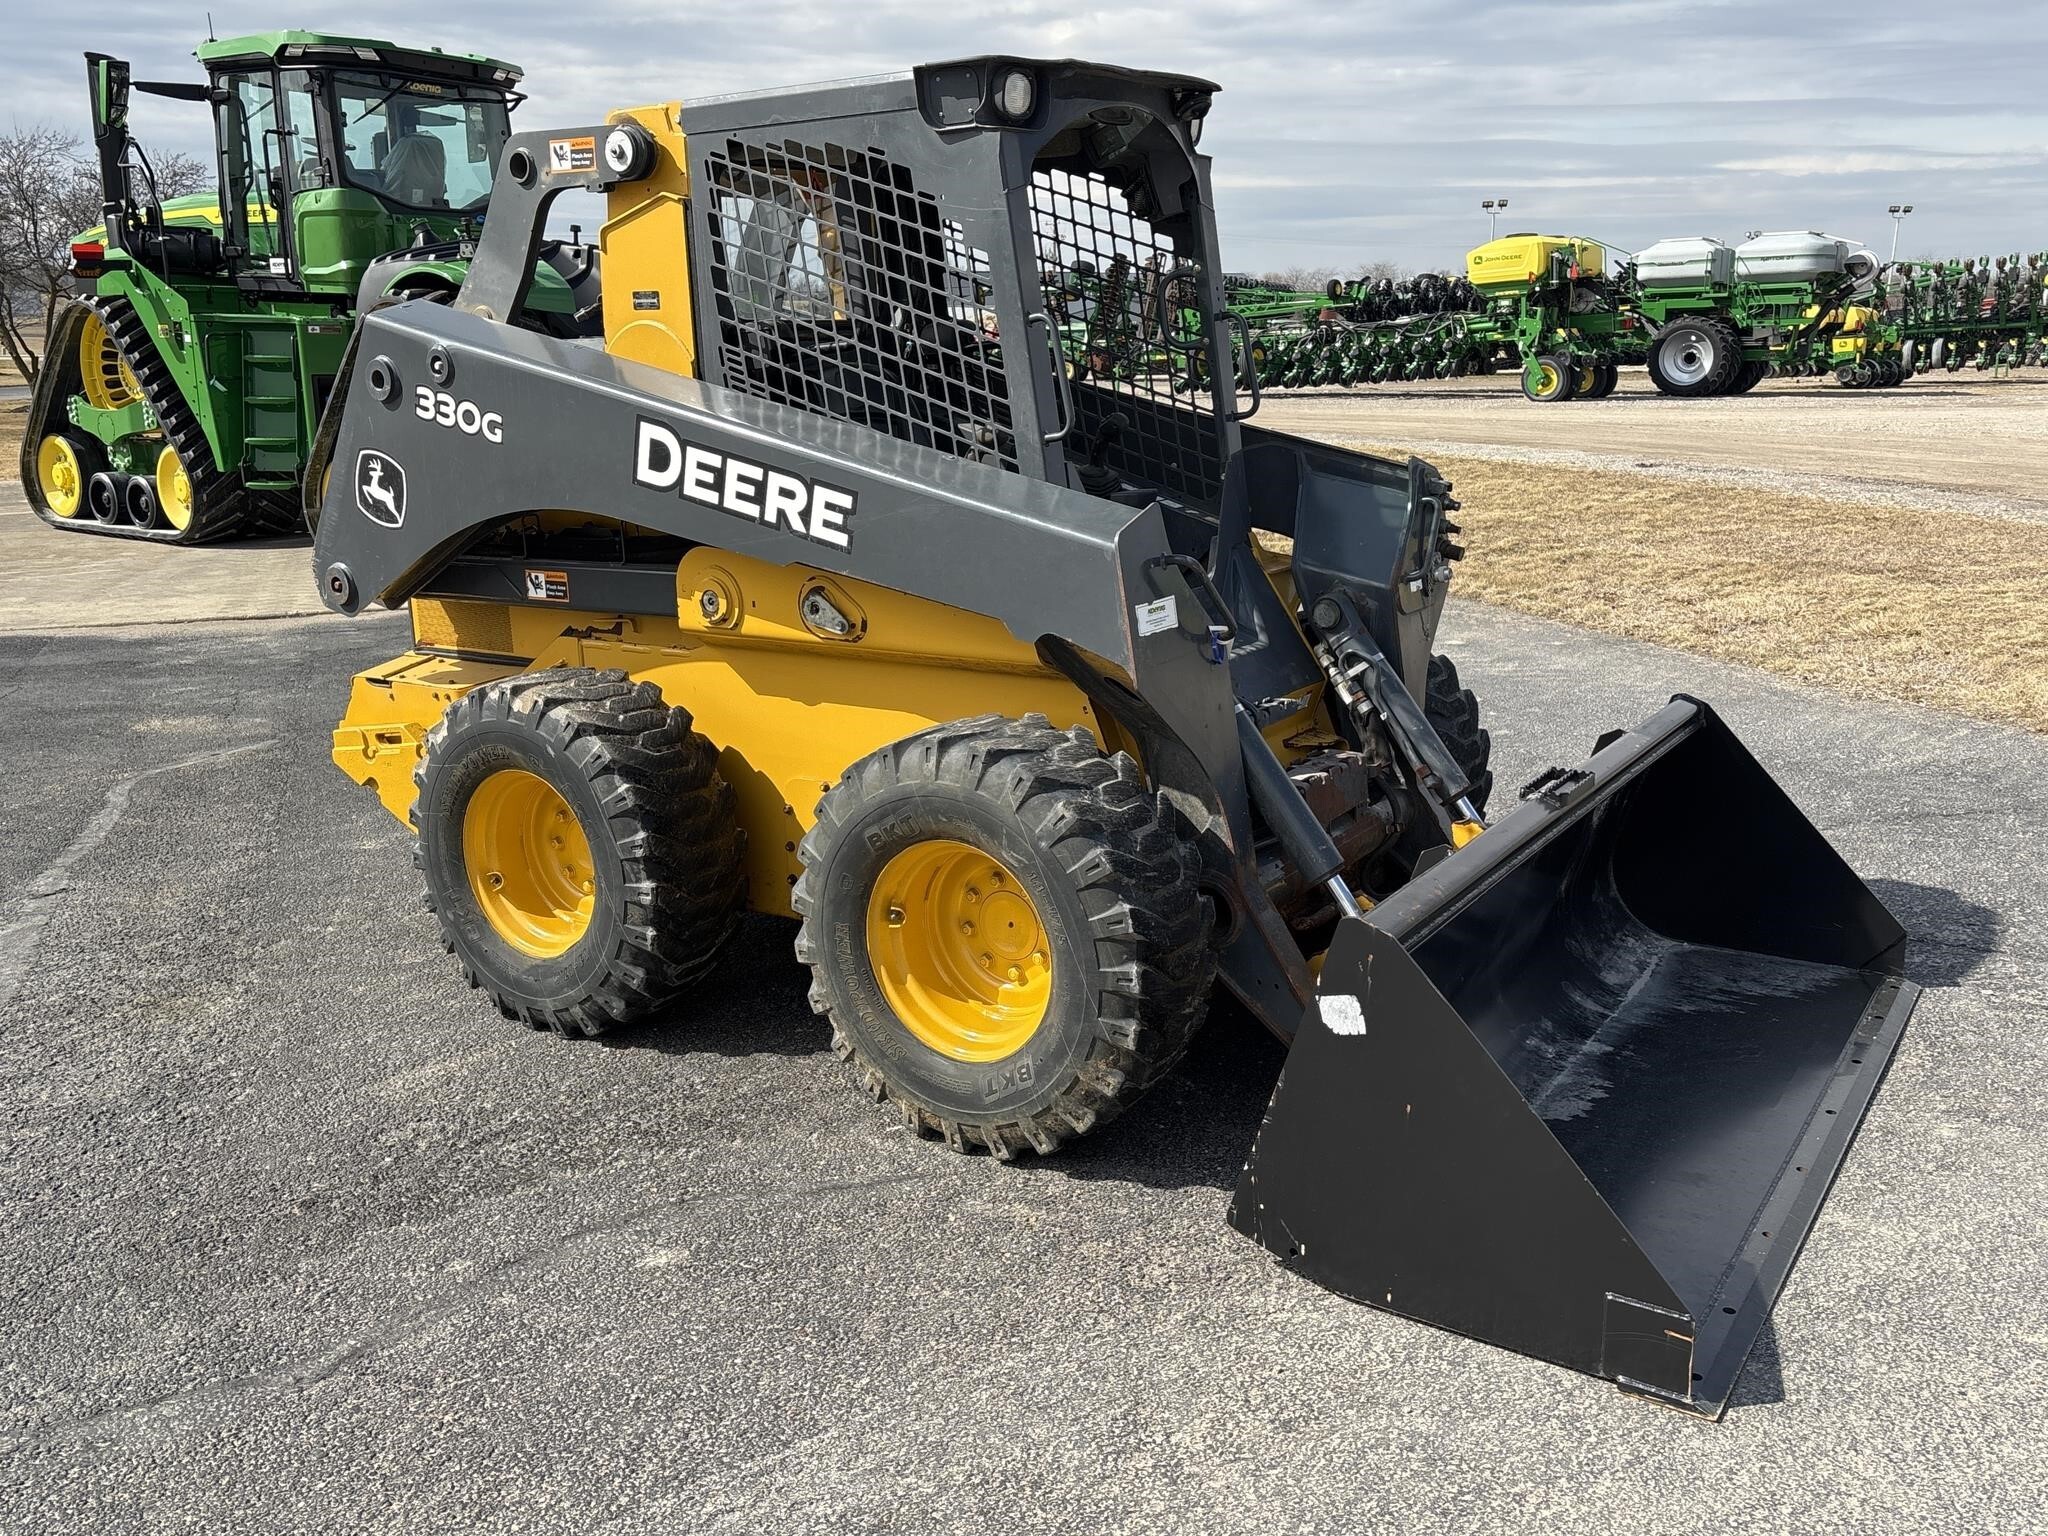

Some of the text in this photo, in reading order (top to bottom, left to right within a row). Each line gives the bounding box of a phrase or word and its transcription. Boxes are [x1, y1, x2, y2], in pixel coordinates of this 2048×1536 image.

[416, 385, 503, 444] 330G
[636, 420, 854, 548] DEERE
[866, 812, 917, 853] BKT
[984, 1062, 1033, 1098] BKT
